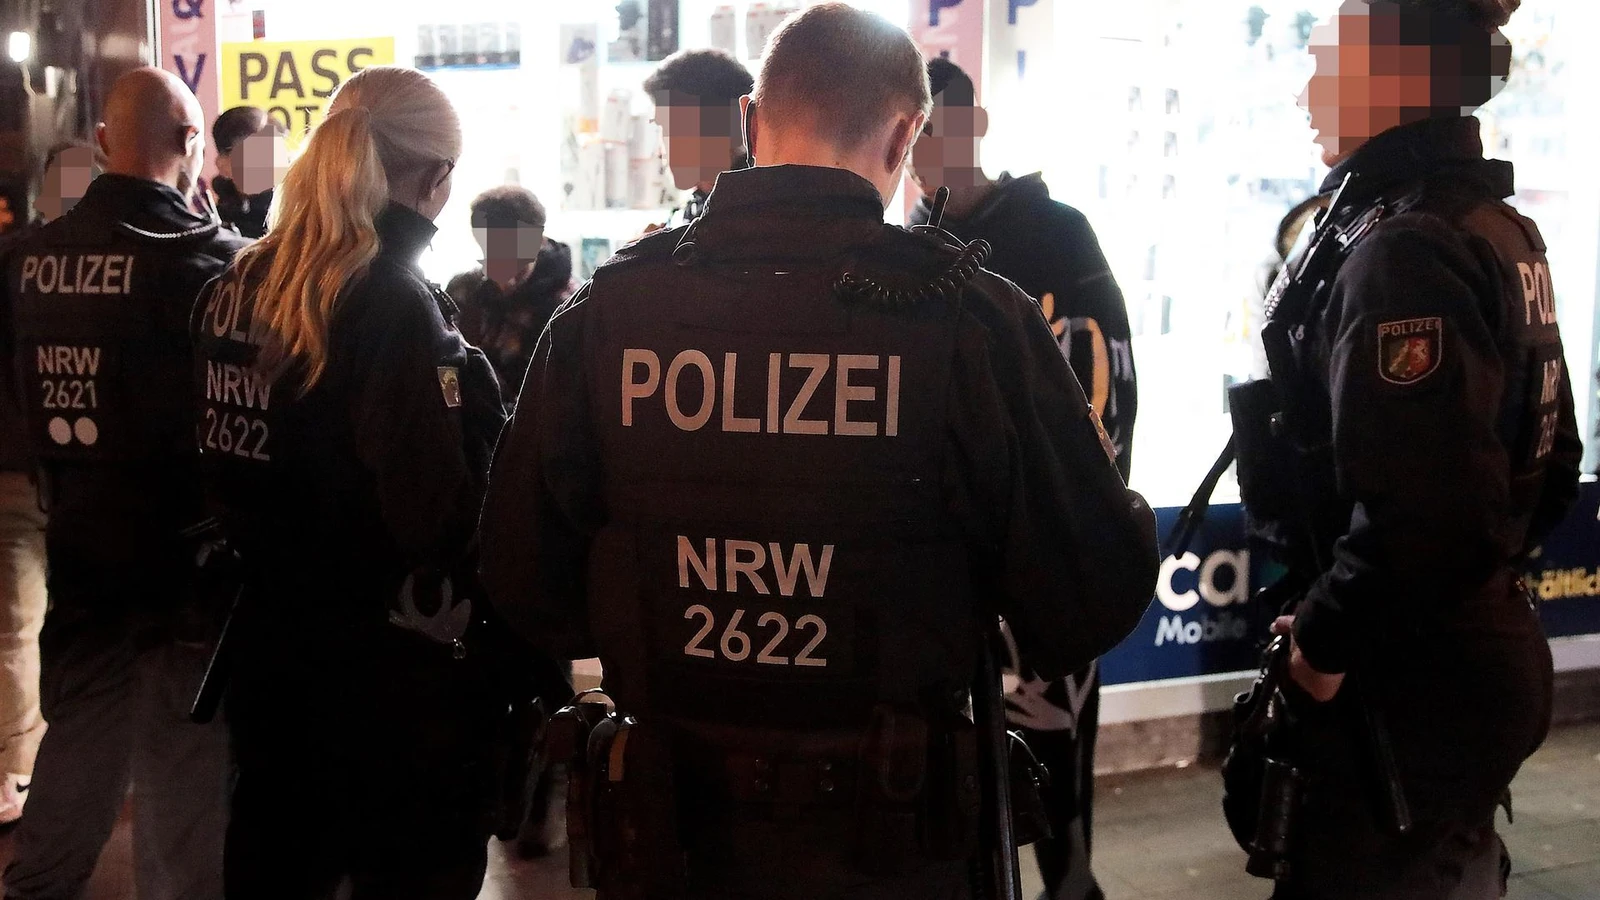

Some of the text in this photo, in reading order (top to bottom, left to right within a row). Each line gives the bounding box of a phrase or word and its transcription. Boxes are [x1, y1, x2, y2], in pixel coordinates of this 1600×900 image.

[20, 255, 134, 294] POLIZEI
[1379, 319, 1442, 337] POLIZEI
[37, 345, 101, 375] NRW
[42, 380, 98, 409] 2621
[207, 360, 271, 411] NRW
[621, 348, 900, 437] POLIZEI
[206, 408, 270, 461] 2622
[677, 535, 834, 598] NRW
[684, 604, 827, 667] 2622
[1154, 614, 1248, 647] Mobile
